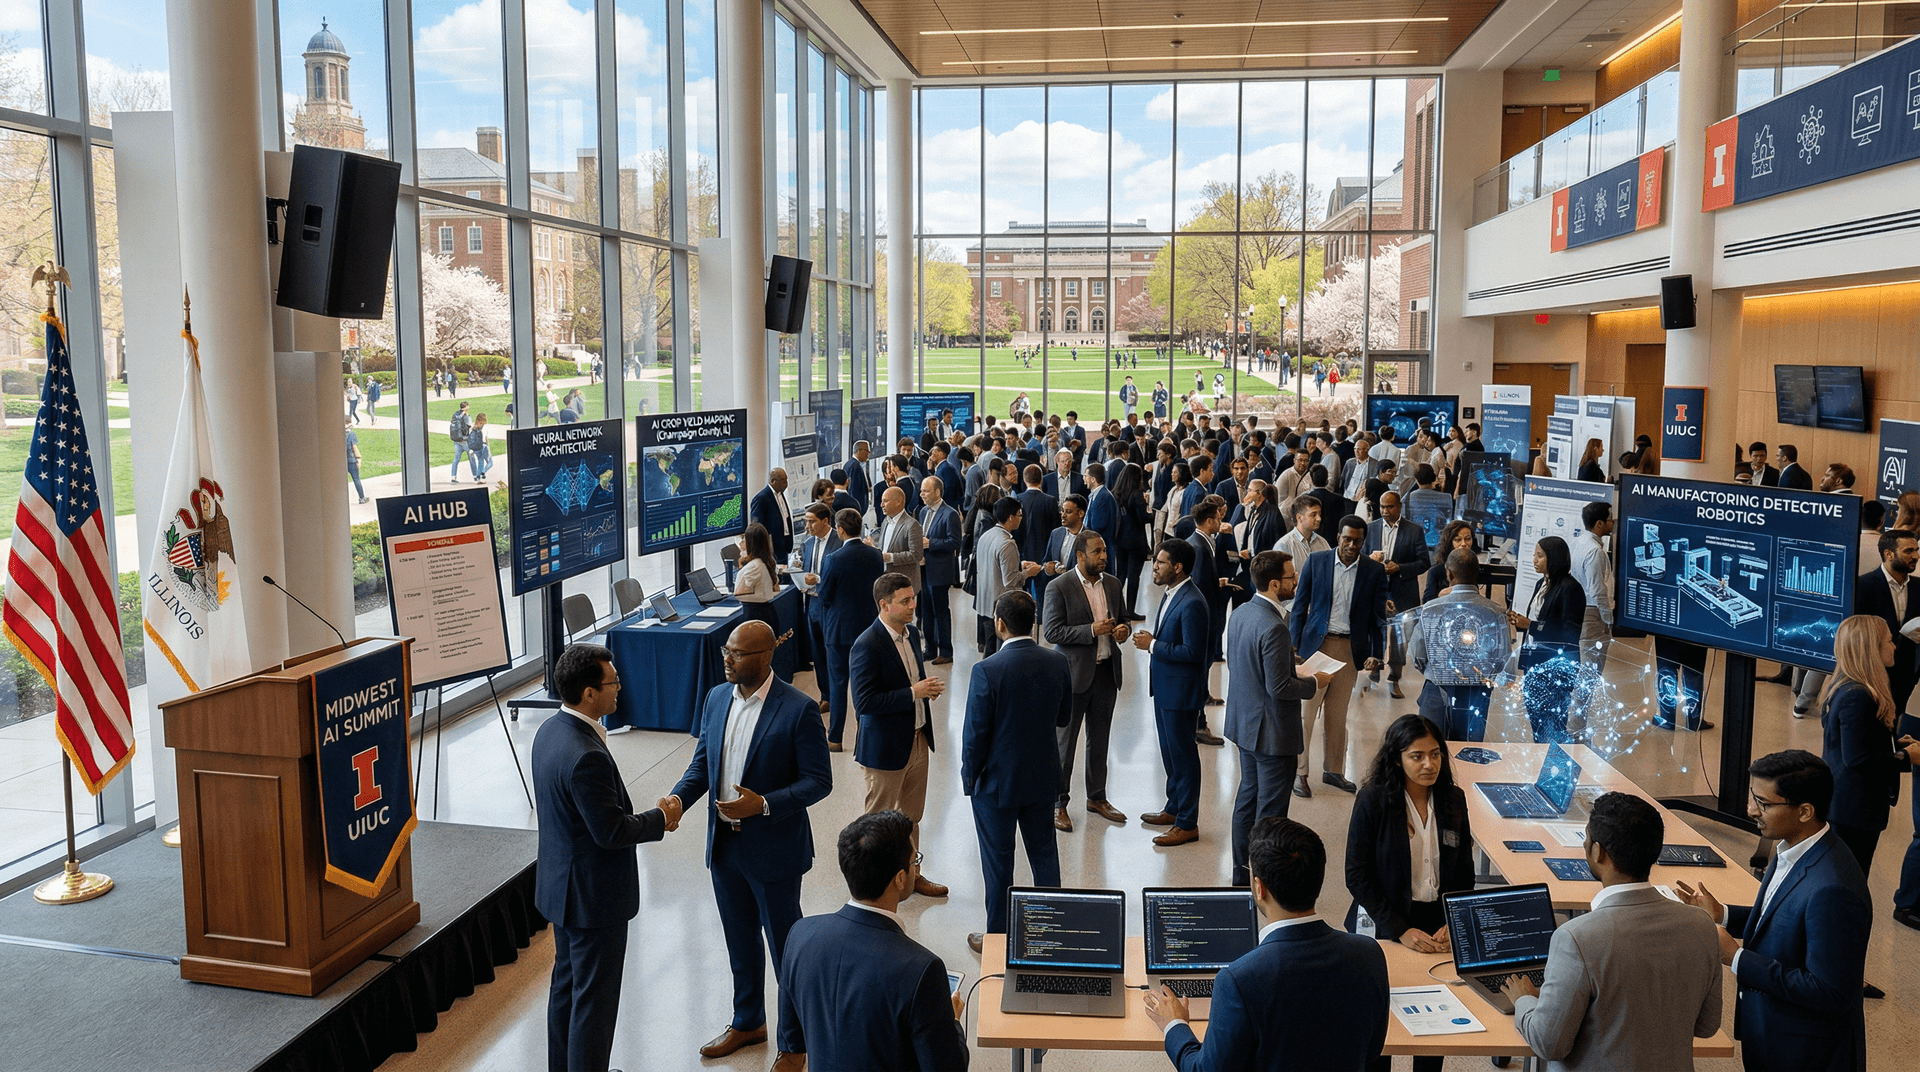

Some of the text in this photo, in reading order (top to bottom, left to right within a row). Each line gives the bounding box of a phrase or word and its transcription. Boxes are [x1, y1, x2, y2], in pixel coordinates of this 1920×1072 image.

[661, 417, 682, 429] CROP
[704, 414, 736, 425] MAPPING
[1666, 424, 1697, 437] UIUC
[532, 426, 603, 445] NEURAL NETWORK
[539, 439, 597, 458] ARCHITECTURE
[404, 500, 468, 525] AI HUB
[1631, 483, 1644, 496] AI
[1647, 484, 1760, 509] MANUFACTORING
[1763, 497, 1843, 518] DETECTIVE
[1696, 506, 1766, 526] ROBOTICS
[148, 571, 204, 640] ILLINOIS
[325, 678, 397, 722] MIDWEST
[322, 698, 400, 746] AI SUMMIT
[347, 805, 390, 841] UIUC
